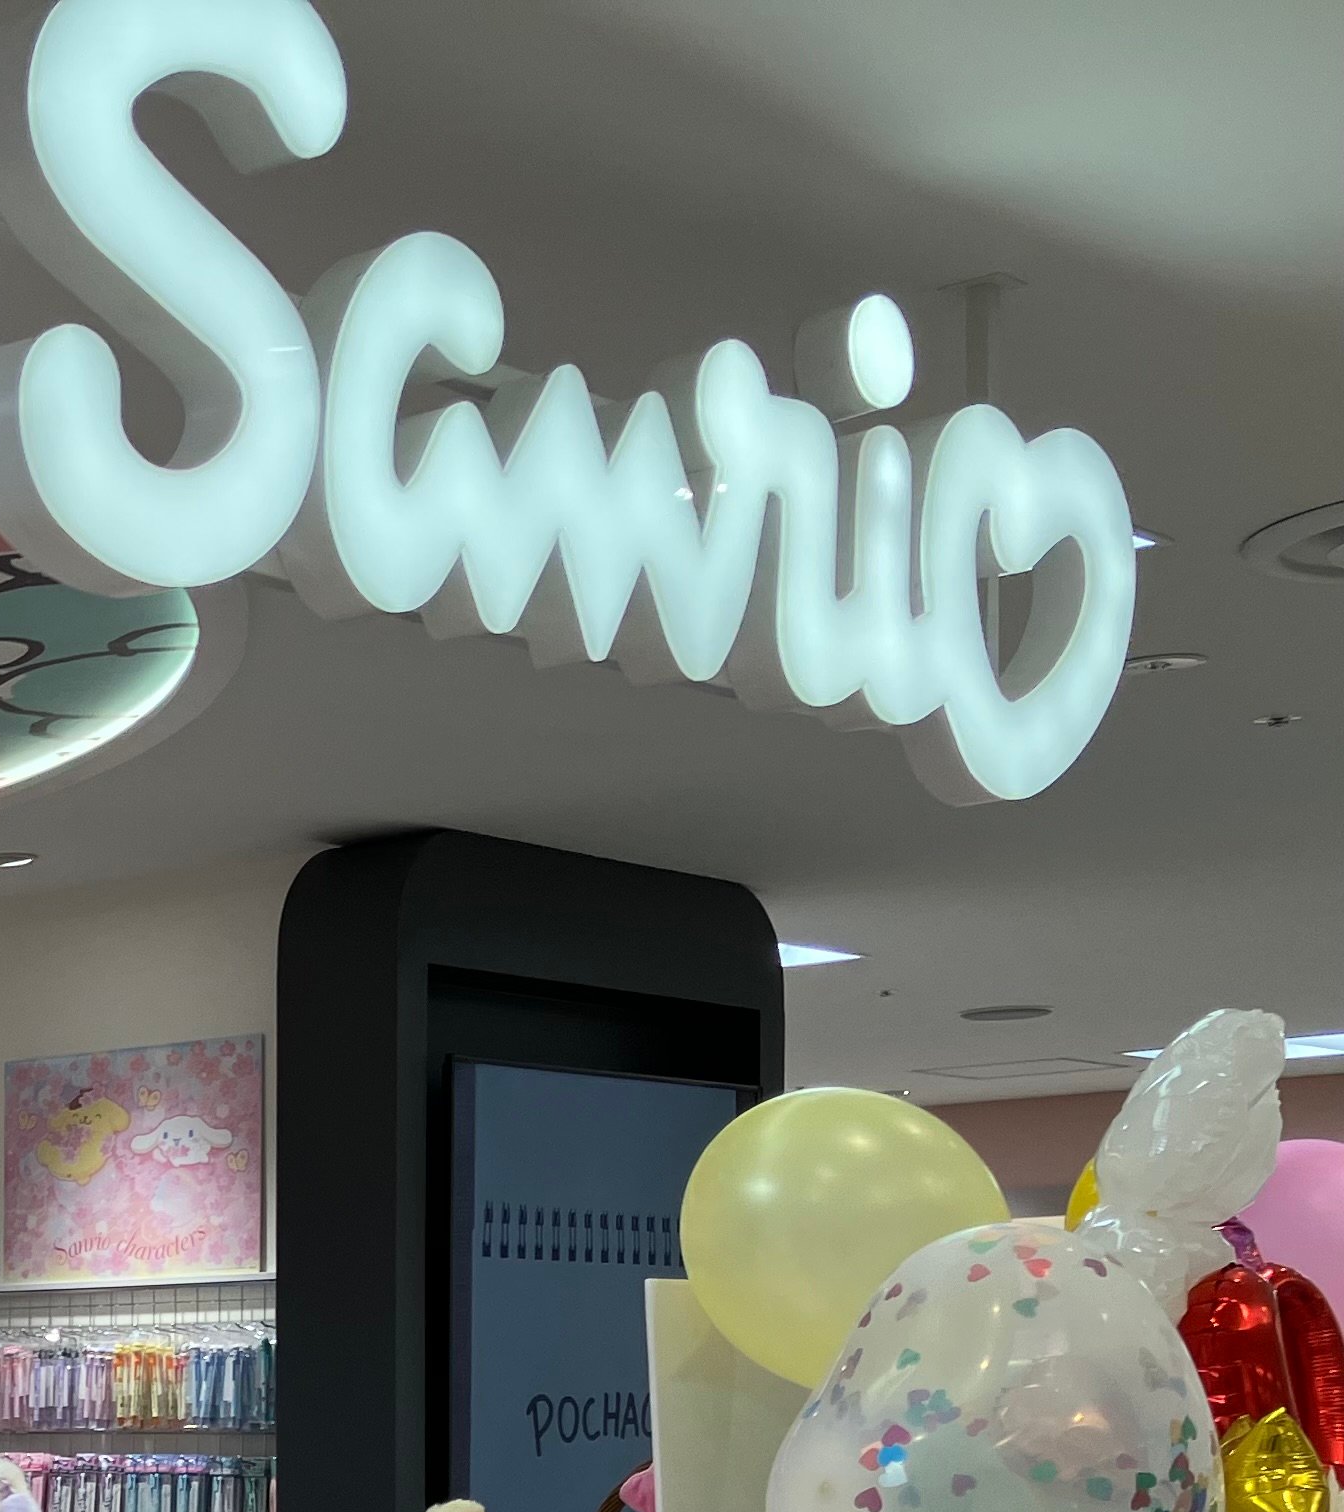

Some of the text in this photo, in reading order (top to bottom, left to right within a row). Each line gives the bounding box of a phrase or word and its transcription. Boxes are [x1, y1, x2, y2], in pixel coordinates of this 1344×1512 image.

[19, 0, 1136, 800] Sanrio
[53, 1228, 207, 1265] Sanrio characters
